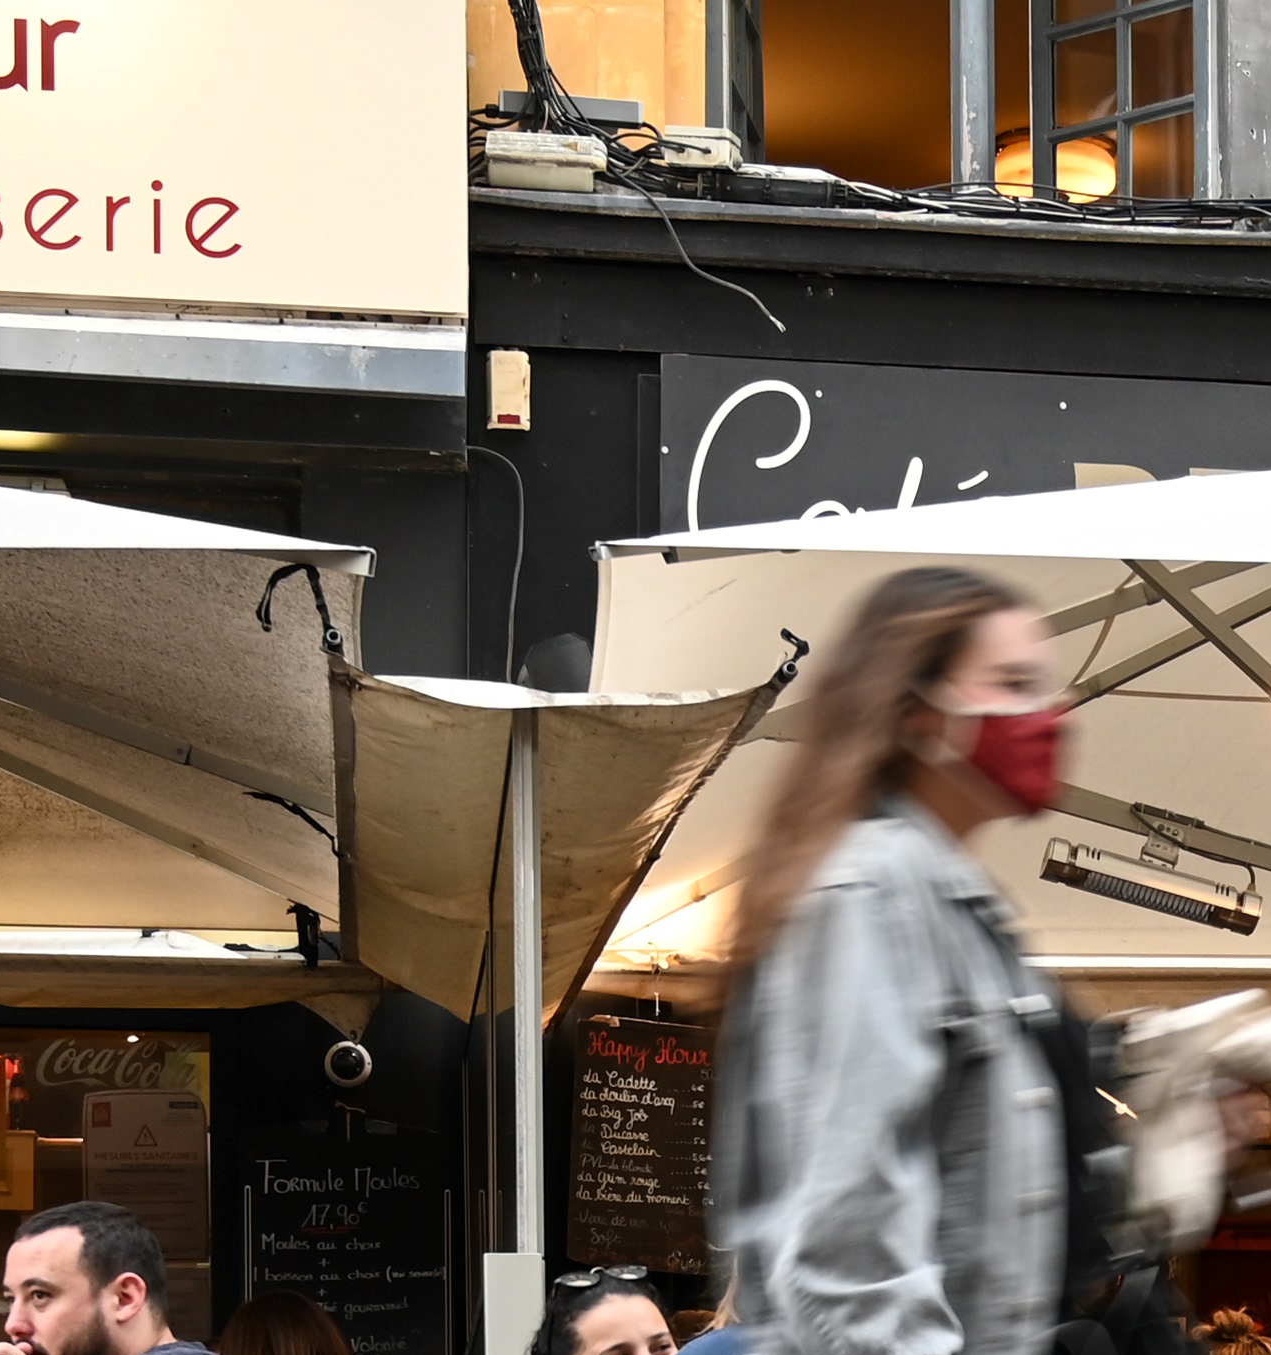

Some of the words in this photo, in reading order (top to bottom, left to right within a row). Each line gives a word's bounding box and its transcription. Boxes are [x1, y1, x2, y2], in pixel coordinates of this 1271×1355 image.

[35, 1035, 201, 1089] Coca-Coa
[587, 1030, 650, 1072] Happy
[654, 1035, 712, 1066] Hour
[605, 1069, 659, 1091] Cadette
[255, 1159, 344, 1195] Formule
[354, 1166, 421, 1198] Moules
[645, 1194, 692, 1206] moment
